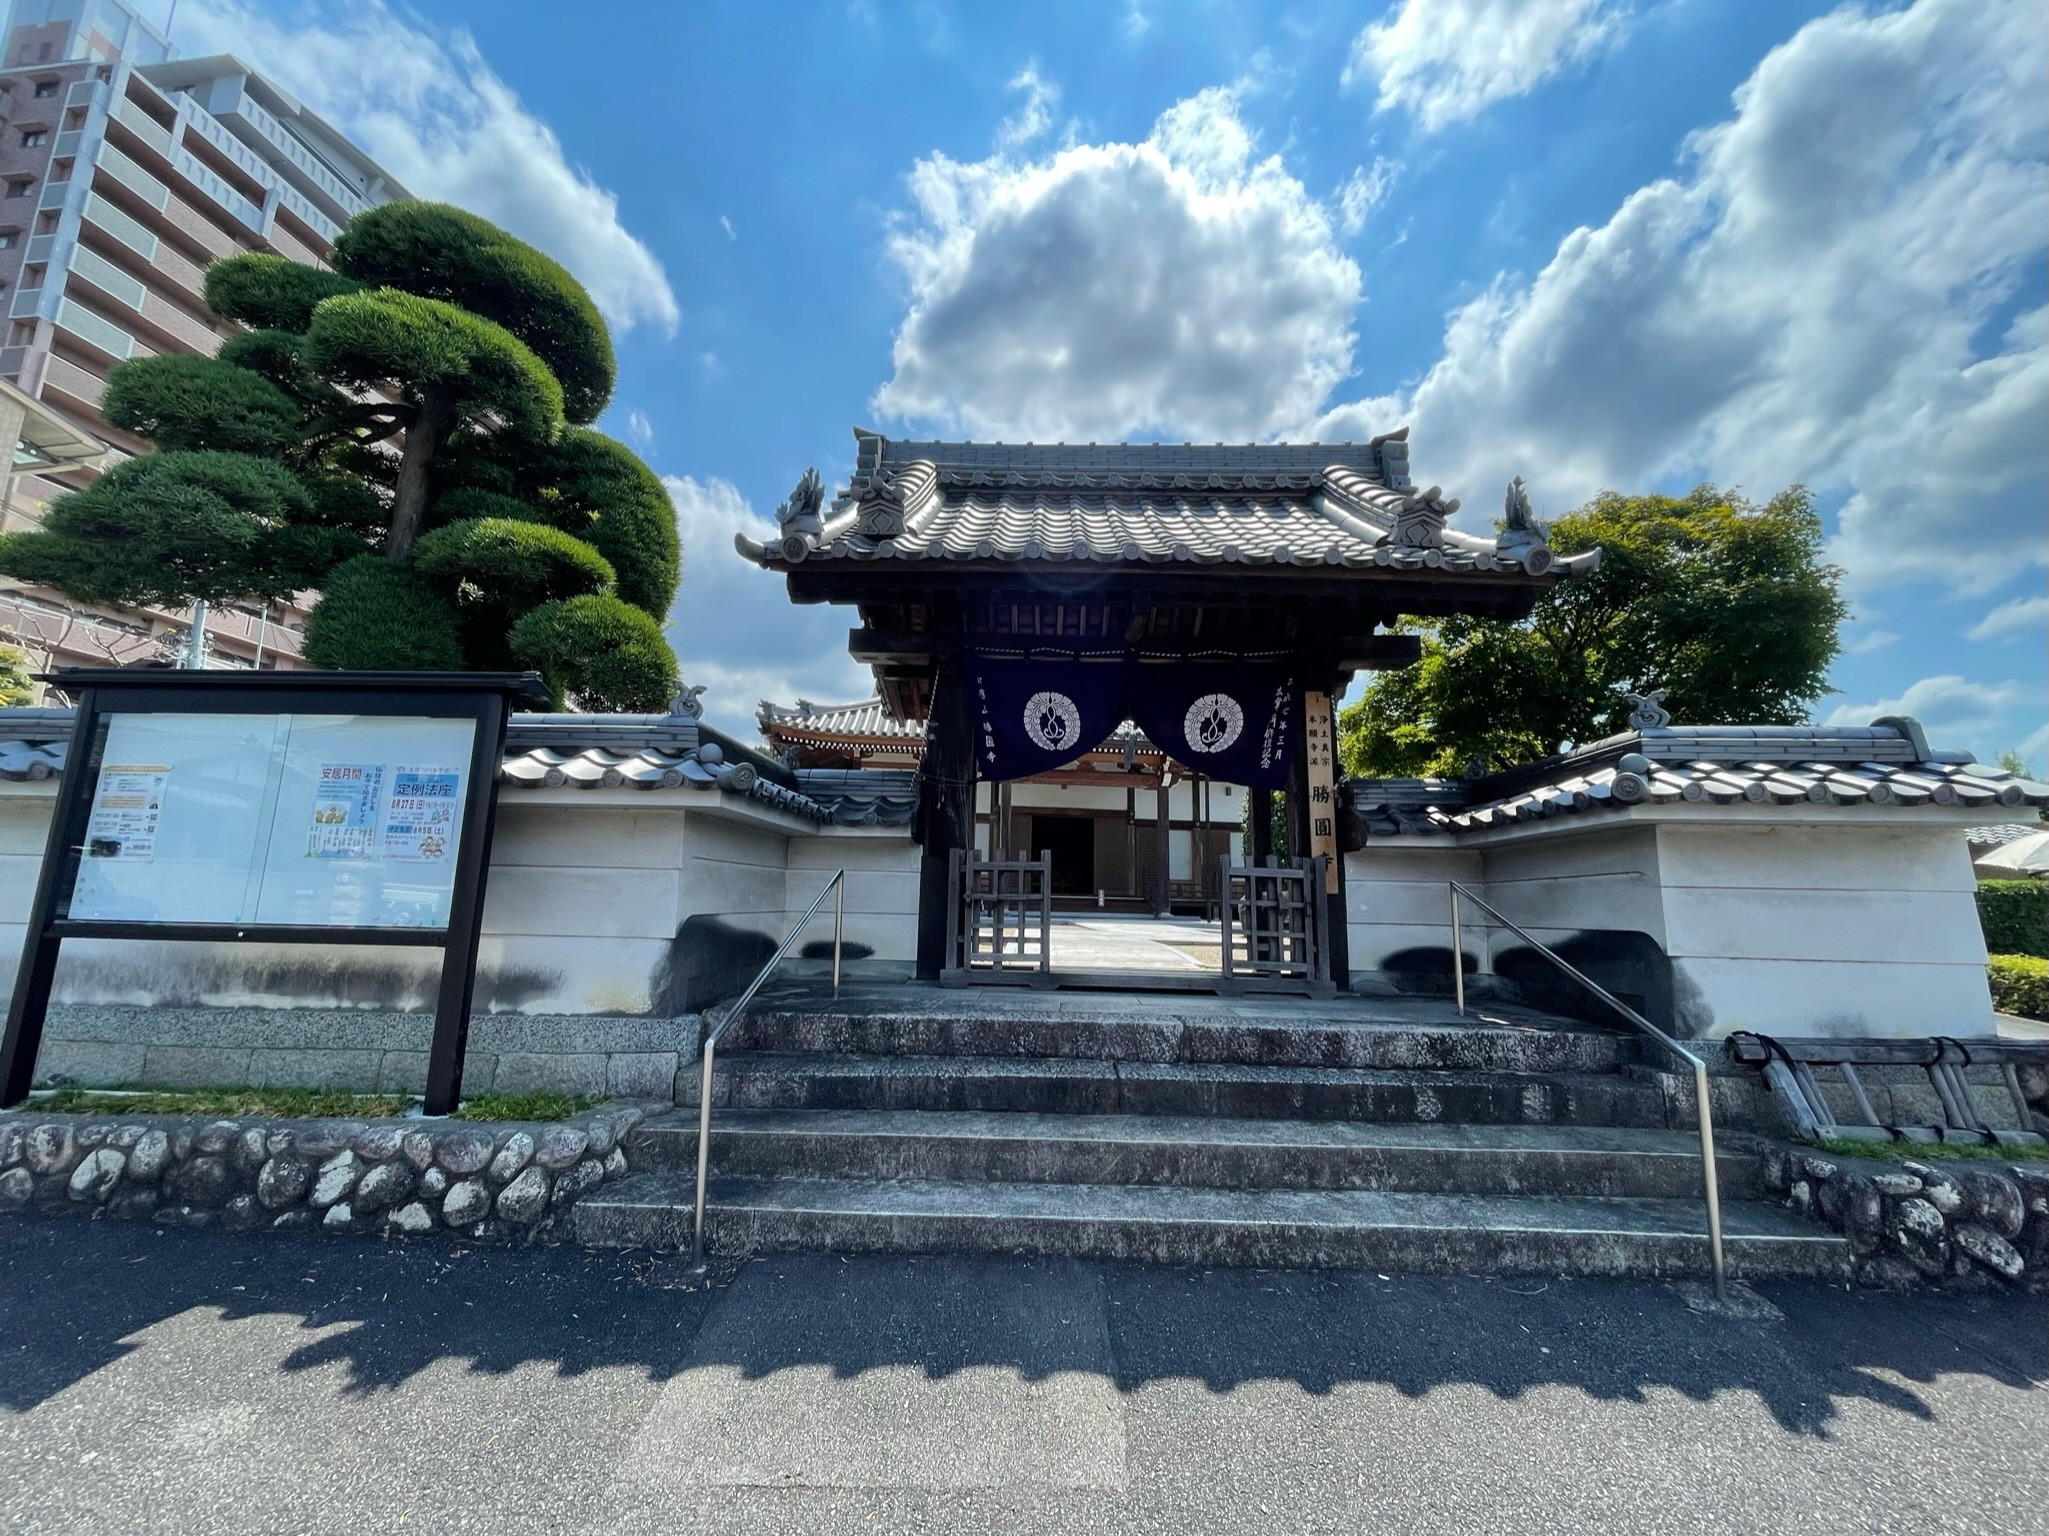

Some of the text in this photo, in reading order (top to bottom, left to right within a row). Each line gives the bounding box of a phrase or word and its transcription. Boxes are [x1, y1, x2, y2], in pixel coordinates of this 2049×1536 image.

[320, 767, 362, 780] 安居月間
[396, 783, 453, 796] 定例法座
